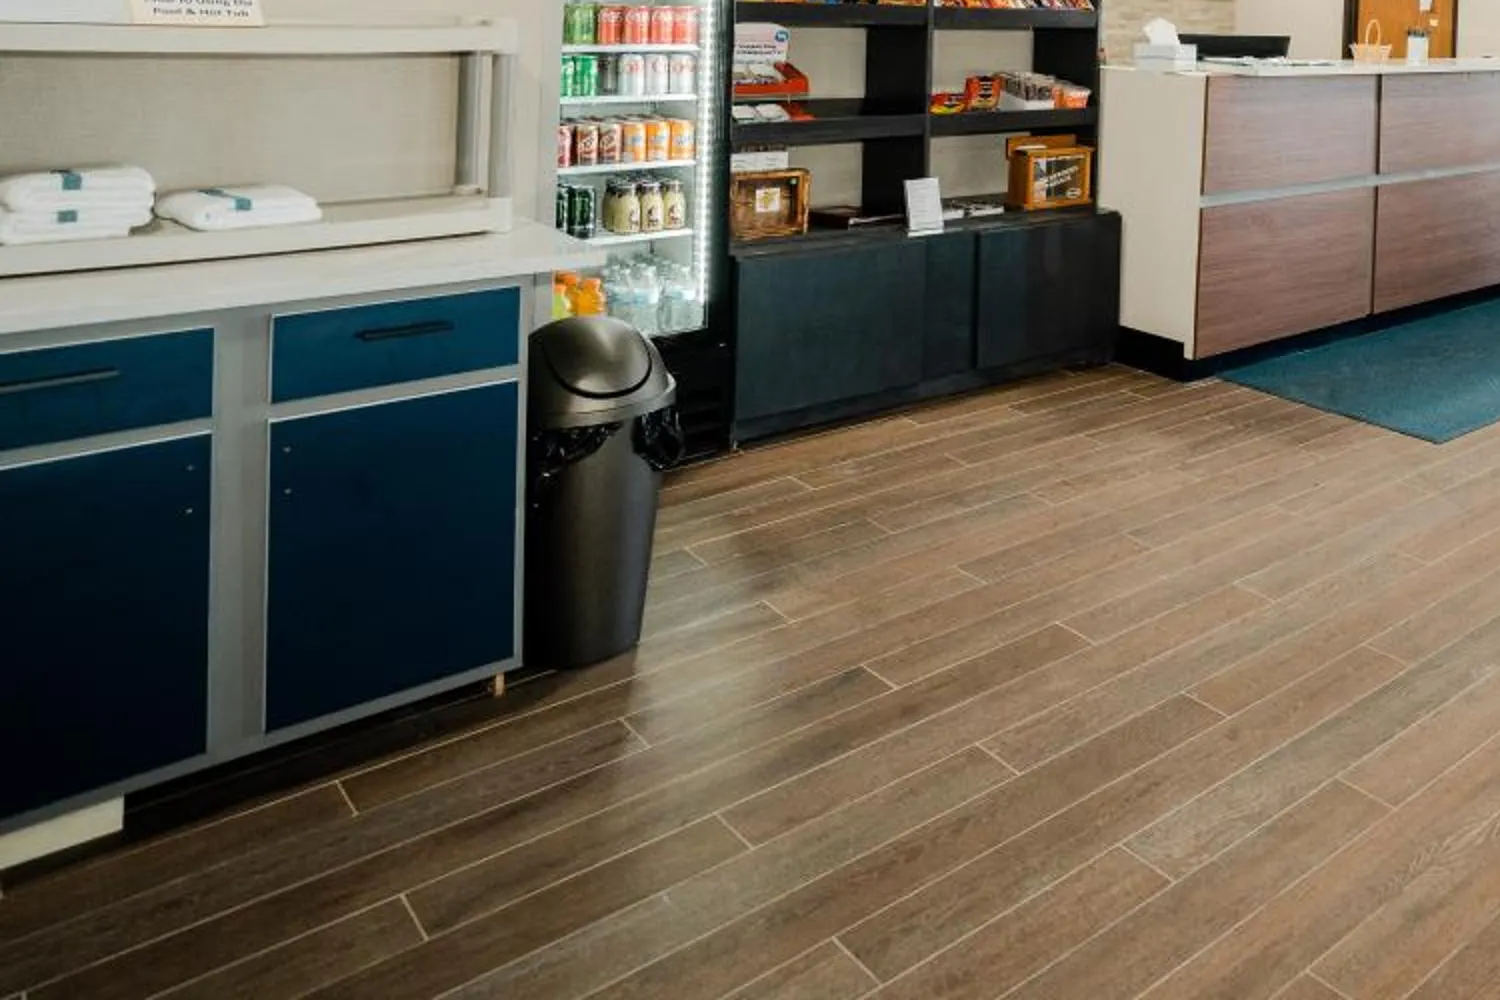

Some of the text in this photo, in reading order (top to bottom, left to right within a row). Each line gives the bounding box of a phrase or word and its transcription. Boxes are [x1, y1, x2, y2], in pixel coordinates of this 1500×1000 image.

[232, 0, 253, 7] the
[152, 7, 249, 18] Pool & Hot Tub
